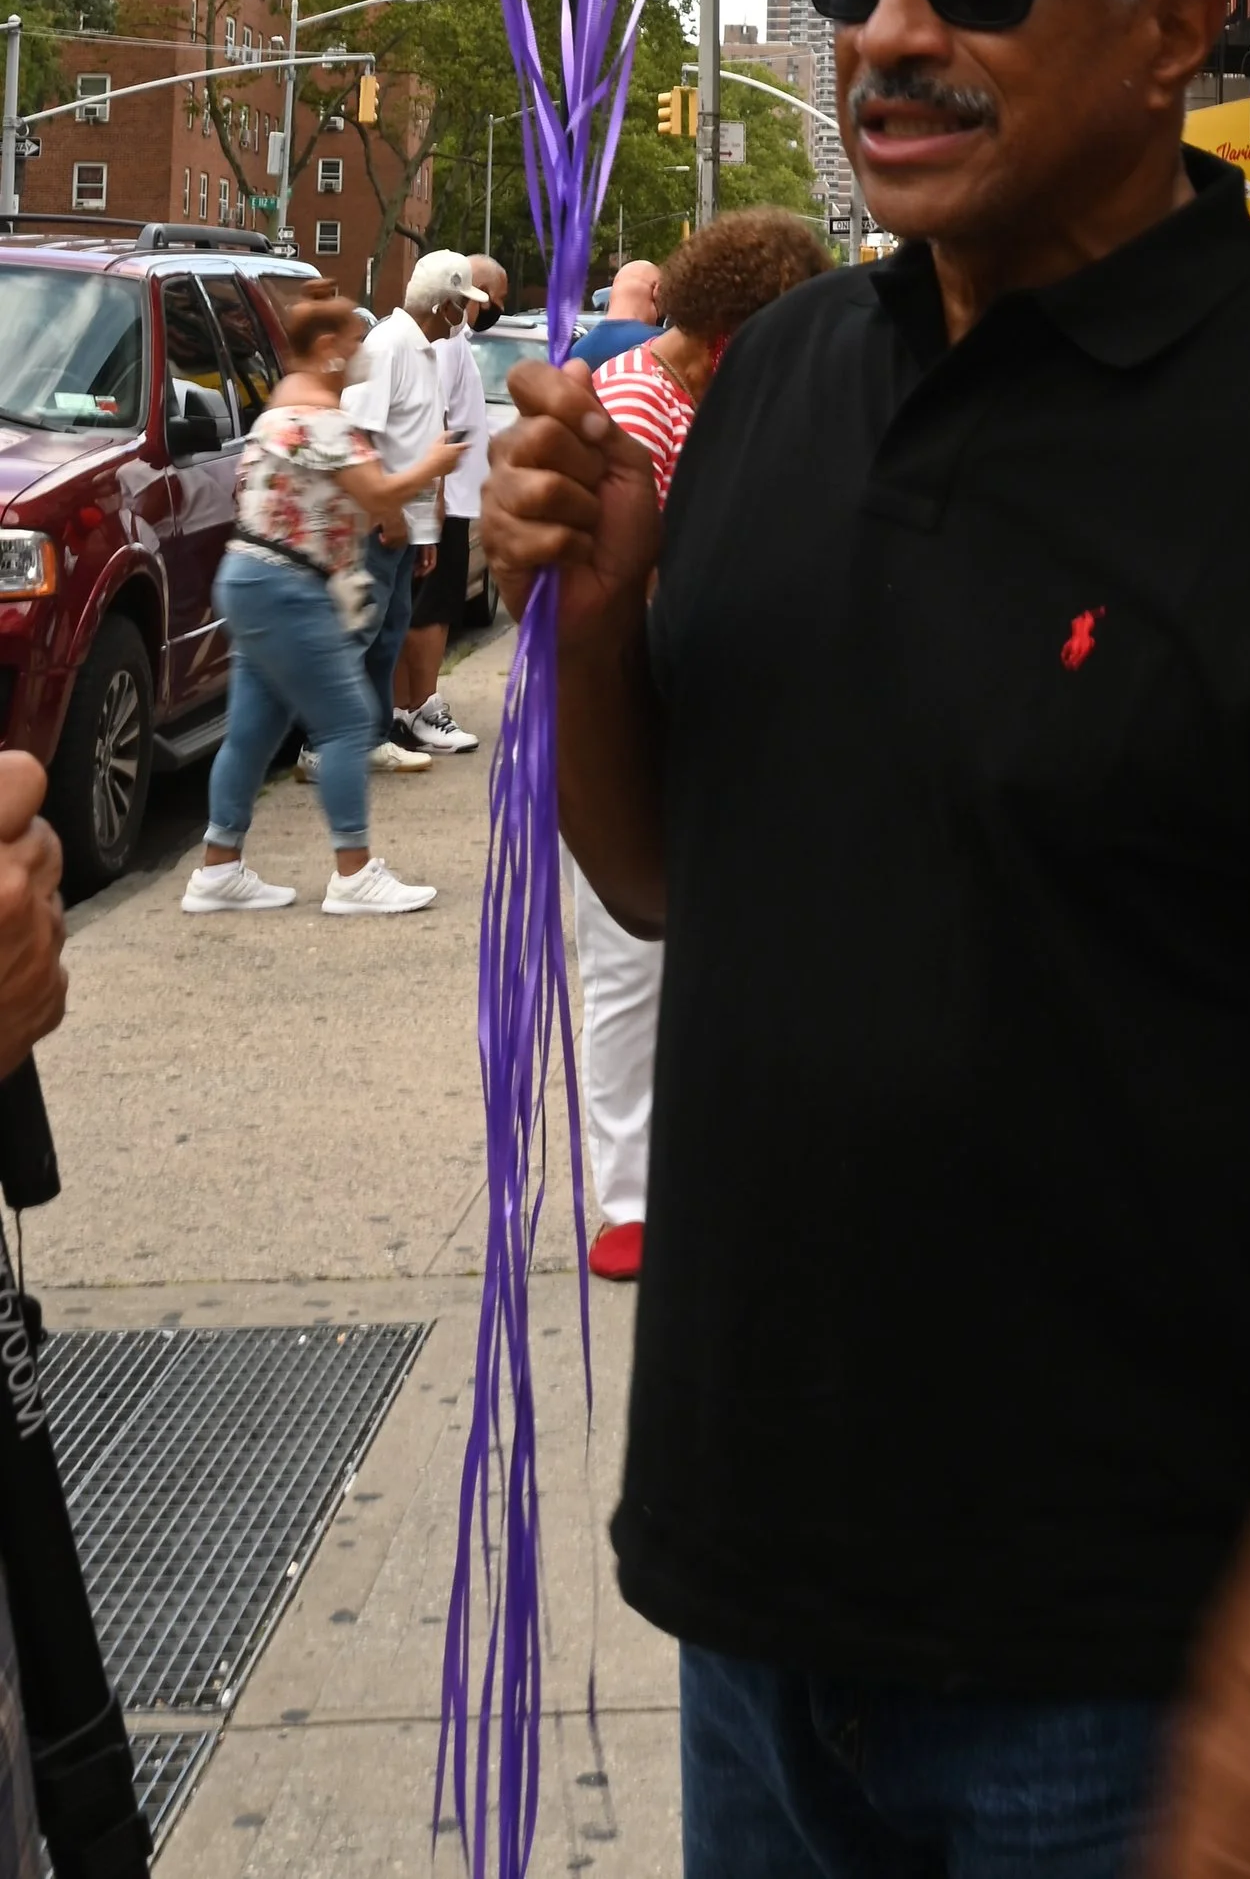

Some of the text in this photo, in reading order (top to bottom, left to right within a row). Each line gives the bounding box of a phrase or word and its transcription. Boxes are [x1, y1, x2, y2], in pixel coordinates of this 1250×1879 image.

[252, 197, 256, 207] E
[259, 197, 268, 207] 112
[836, 221, 850, 230] ON
